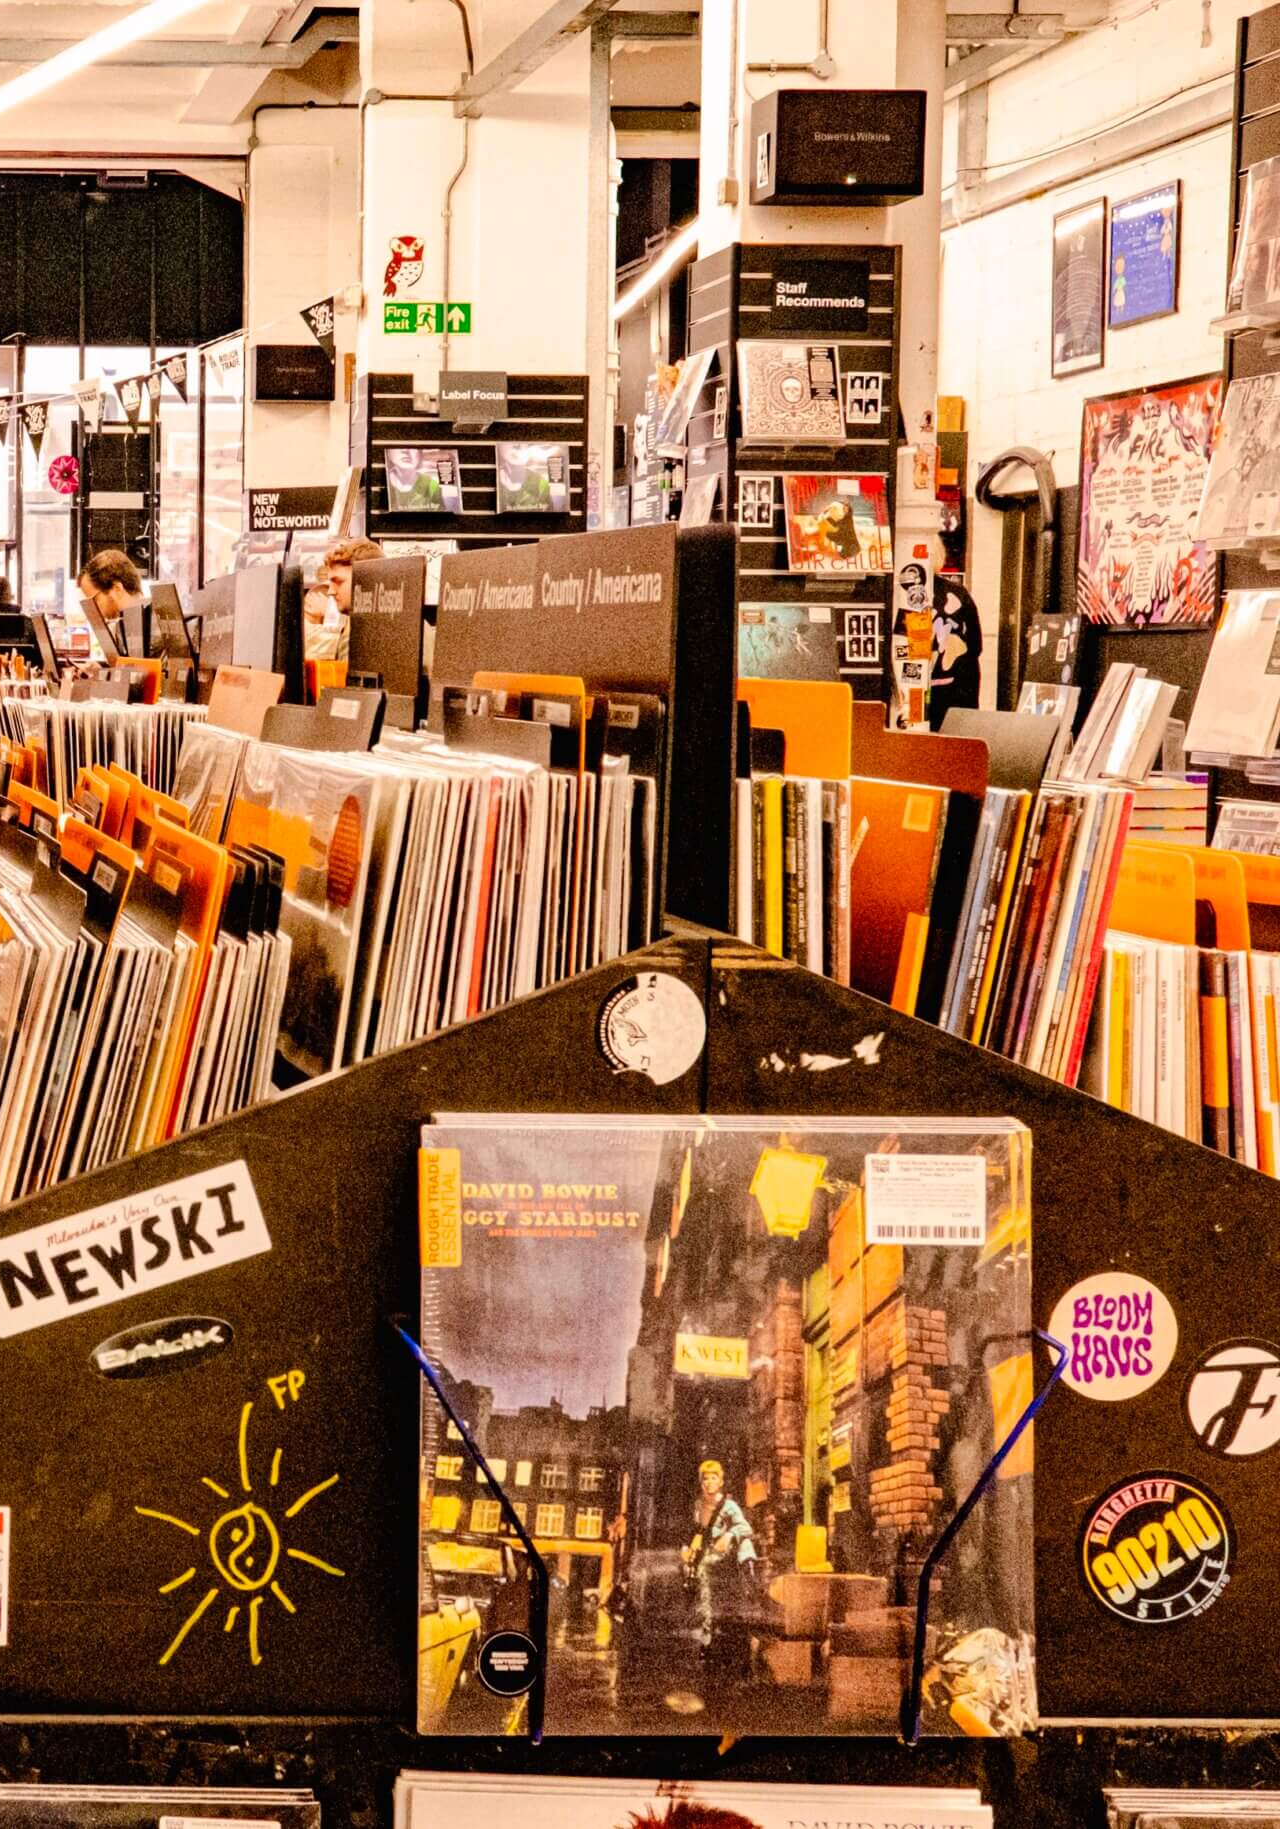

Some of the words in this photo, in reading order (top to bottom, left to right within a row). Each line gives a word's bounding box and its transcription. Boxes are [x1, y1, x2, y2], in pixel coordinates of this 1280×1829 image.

[776, 282, 808, 294] Staff
[386, 306, 410, 318] Fire
[776, 295, 865, 308] Recommends
[386, 319, 410, 330] exit
[442, 390, 470, 400] Label
[473, 391, 505, 400] Focus
[253, 493, 280, 505] NEW
[253, 505, 276, 516] AND
[253, 515, 332, 529] NOTEWORTHY
[443, 582, 475, 617] Country
[482, 579, 533, 609] Americana
[540, 573, 583, 612] Country
[593, 567, 661, 606] Americana
[1022, 687, 1065, 714] Art
[428, 1154, 440, 1206] TRADE
[462, 1183, 535, 1199] DAVID
[541, 1183, 619, 1199] BOWIE
[440, 1168, 457, 1263] ESSENTIAL
[461, 1210, 509, 1226] GGY
[519, 1211, 640, 1227] STARDUST
[428, 1209, 440, 1263] ROUGH
[1073, 1291, 1153, 1335] BLOOM
[1071, 1332, 1153, 1383] HAUS
[267, 1369, 306, 1409] FP
[1092, 1498, 1221, 1605] 90210
